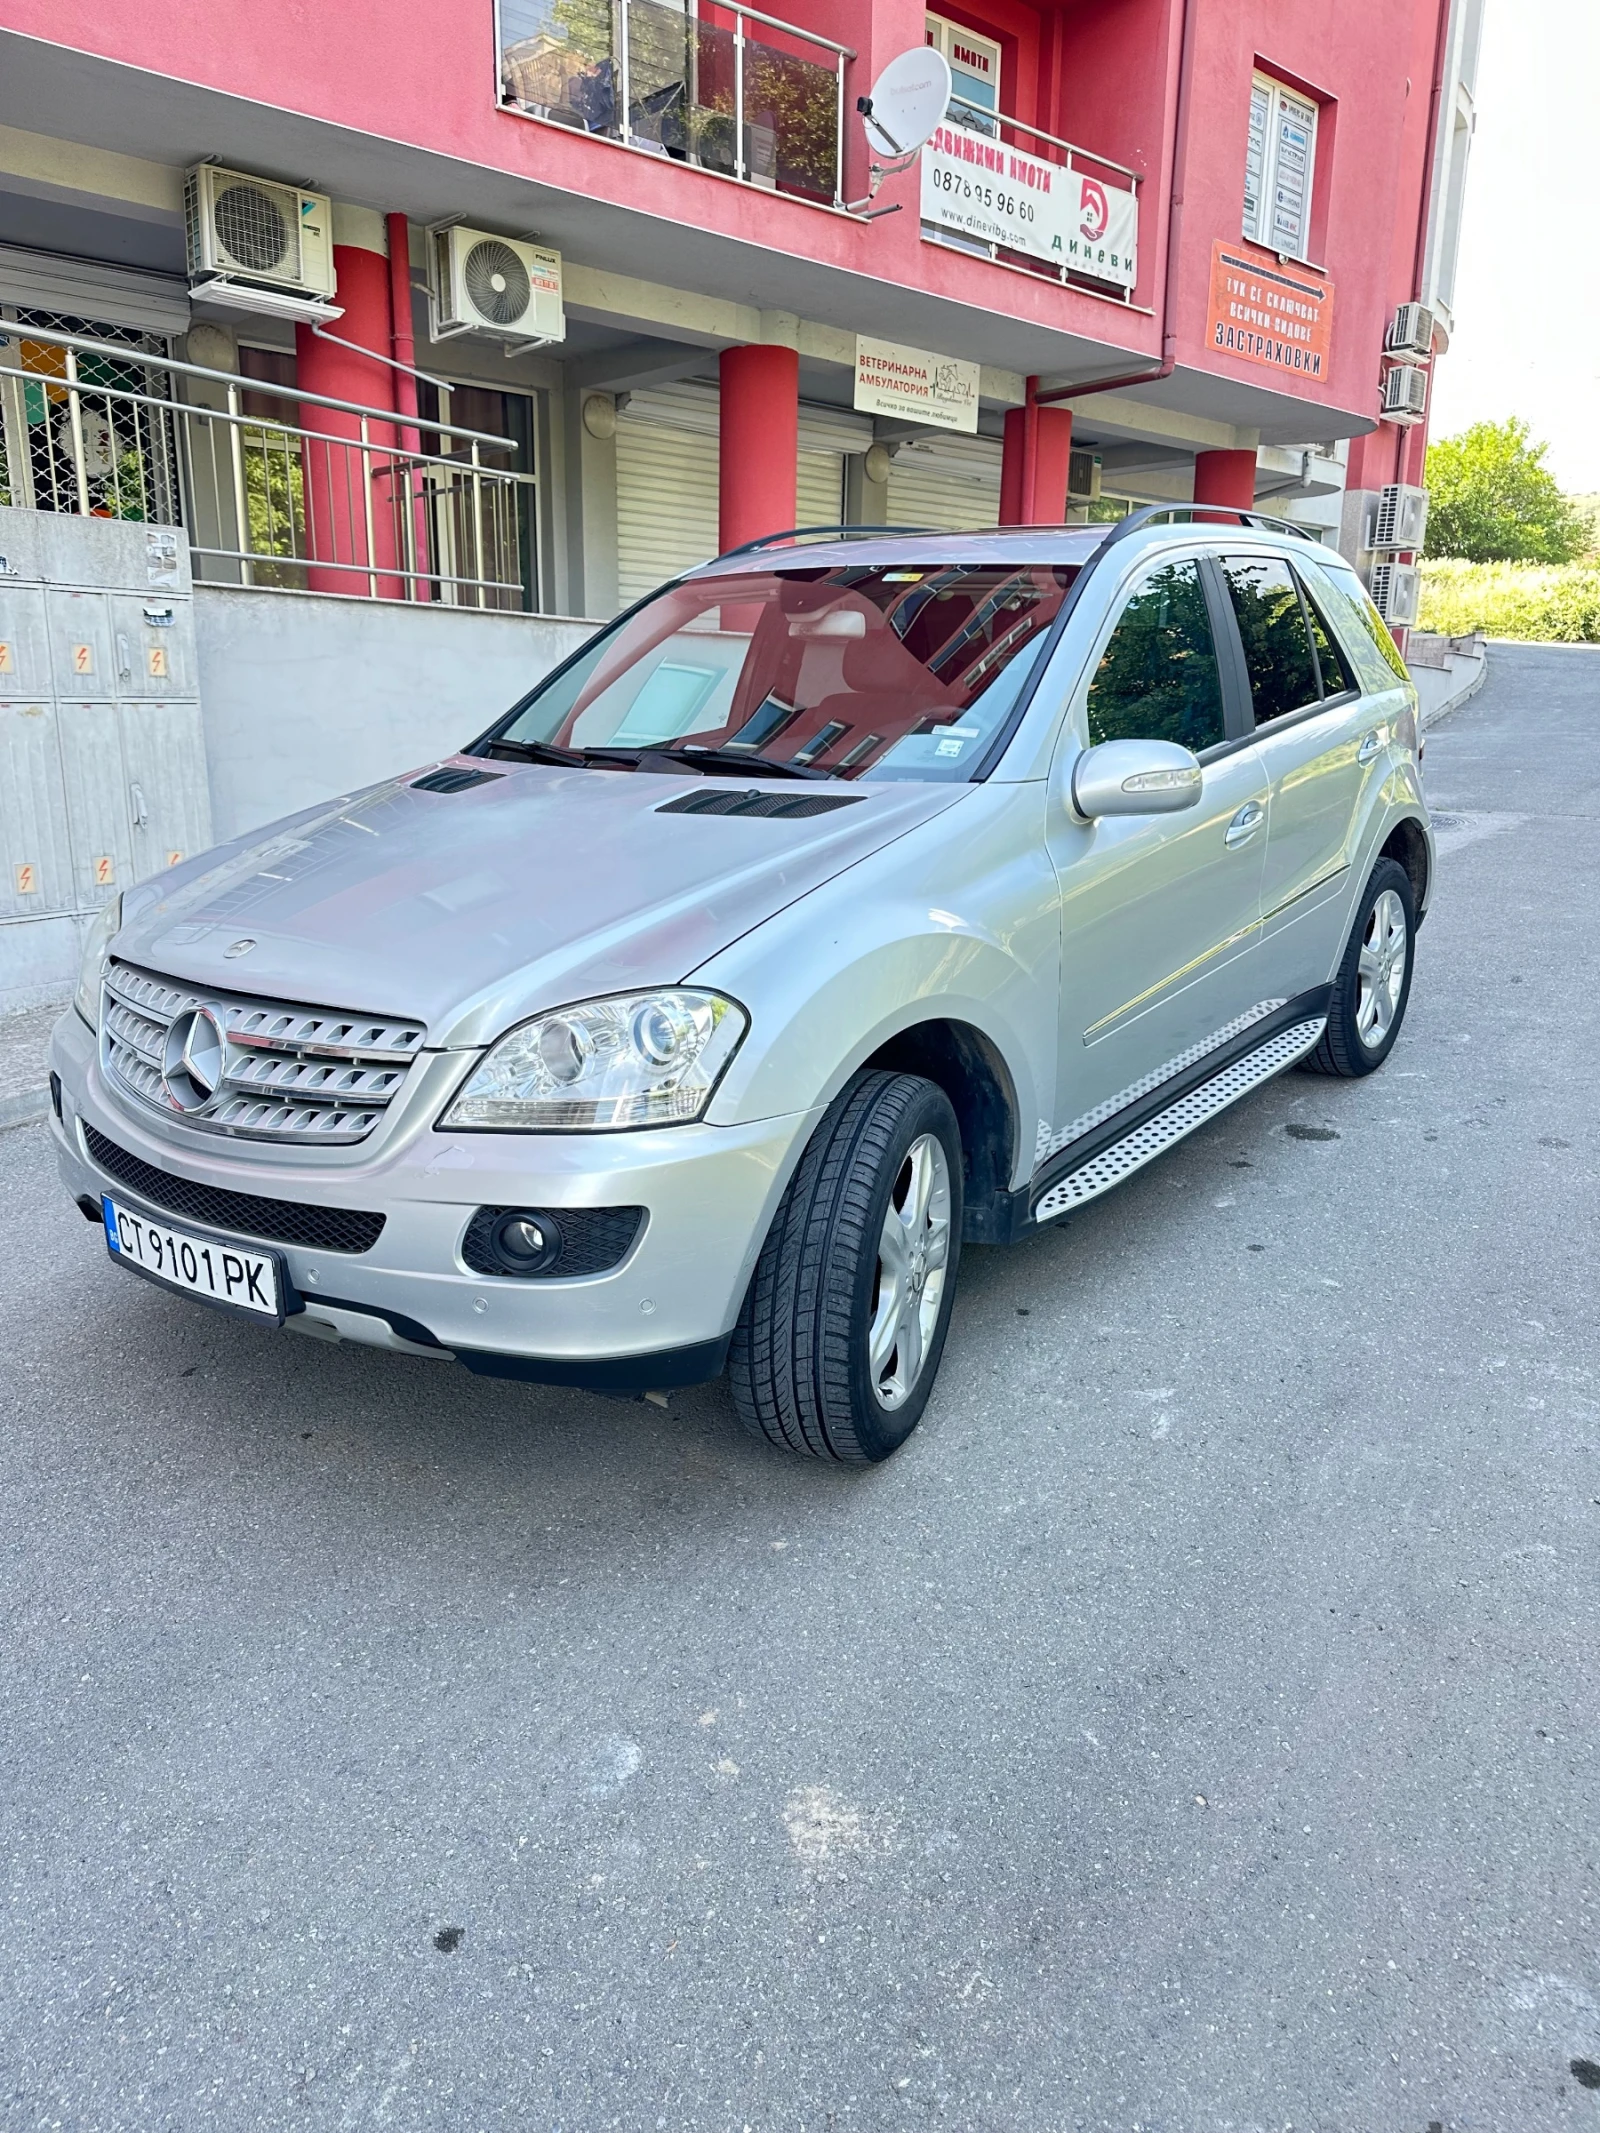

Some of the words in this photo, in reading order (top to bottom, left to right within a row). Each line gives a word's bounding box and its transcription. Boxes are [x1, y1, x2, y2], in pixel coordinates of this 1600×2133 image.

[954, 44, 989, 72] ИМОТИ
[926, 126, 1004, 175] ДВИЖИМИ
[1010, 155, 1051, 194] ИМОТИ
[941, 207, 1026, 246] www.dinevibg.com
[997, 193, 1014, 215] 96
[1020, 201, 1034, 222] 60
[1227, 277, 1246, 298] ТУК
[1250, 285, 1263, 303] СЕ
[1266, 292, 1319, 322] СКЛЮЧВАТ
[1230, 302, 1271, 329] ВСИЧКИ
[1274, 317, 1312, 342] ВИДОВЕ
[860, 354, 928, 380] ВЕТЕРИНАРНА
[1215, 322, 1321, 375] ЗАСТРАХОВКИ
[859, 372, 929, 397] АМБУЛАТОРИЯ
[876, 398, 898, 410] Всичко
[898, 404, 906, 412] за
[906, 406, 931, 417] вашите
[149, 1229, 215, 1291] 9101
